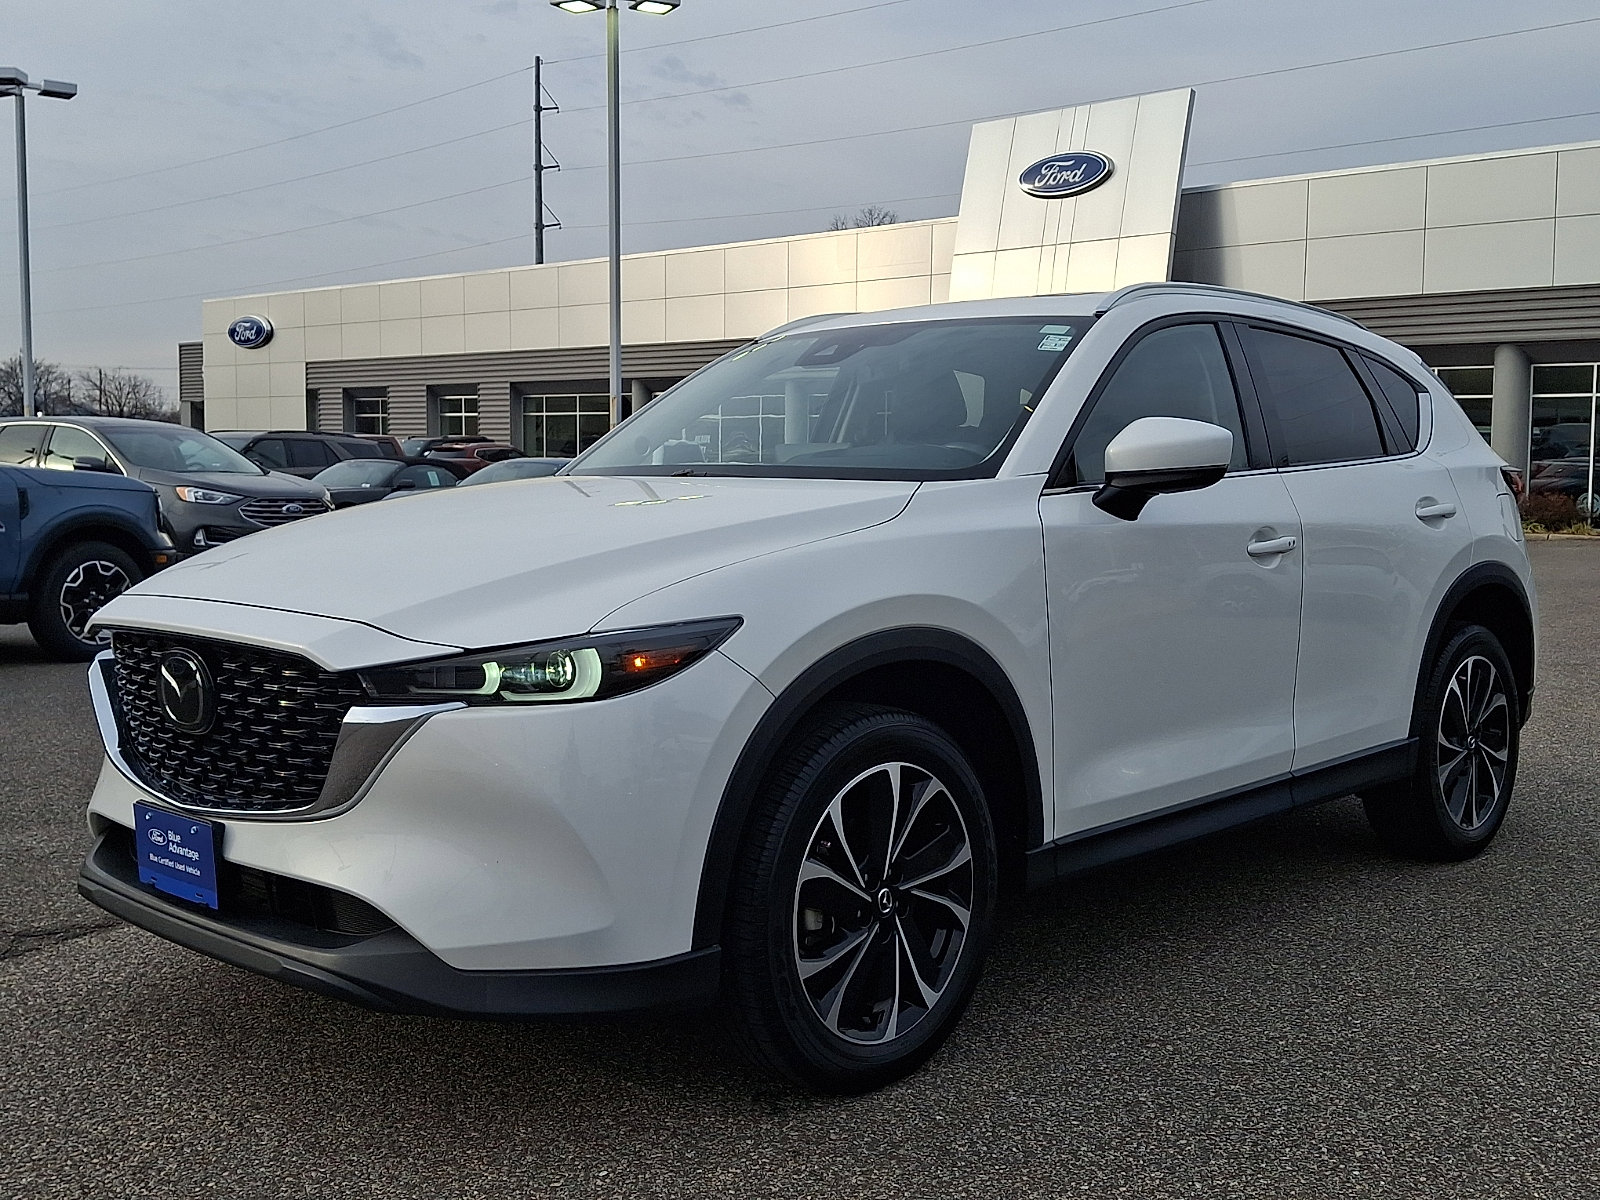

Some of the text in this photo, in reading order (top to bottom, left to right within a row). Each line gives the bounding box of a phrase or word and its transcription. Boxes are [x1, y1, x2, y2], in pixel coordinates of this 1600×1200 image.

[1035, 160, 1088, 187] Ford
[234, 322, 257, 341] Ford
[152, 830, 164, 843] Ford
[167, 830, 182, 843] Blue
[168, 842, 200, 861] Advantage
[149, 853, 201, 877] Blue Certified Used Vehicle
